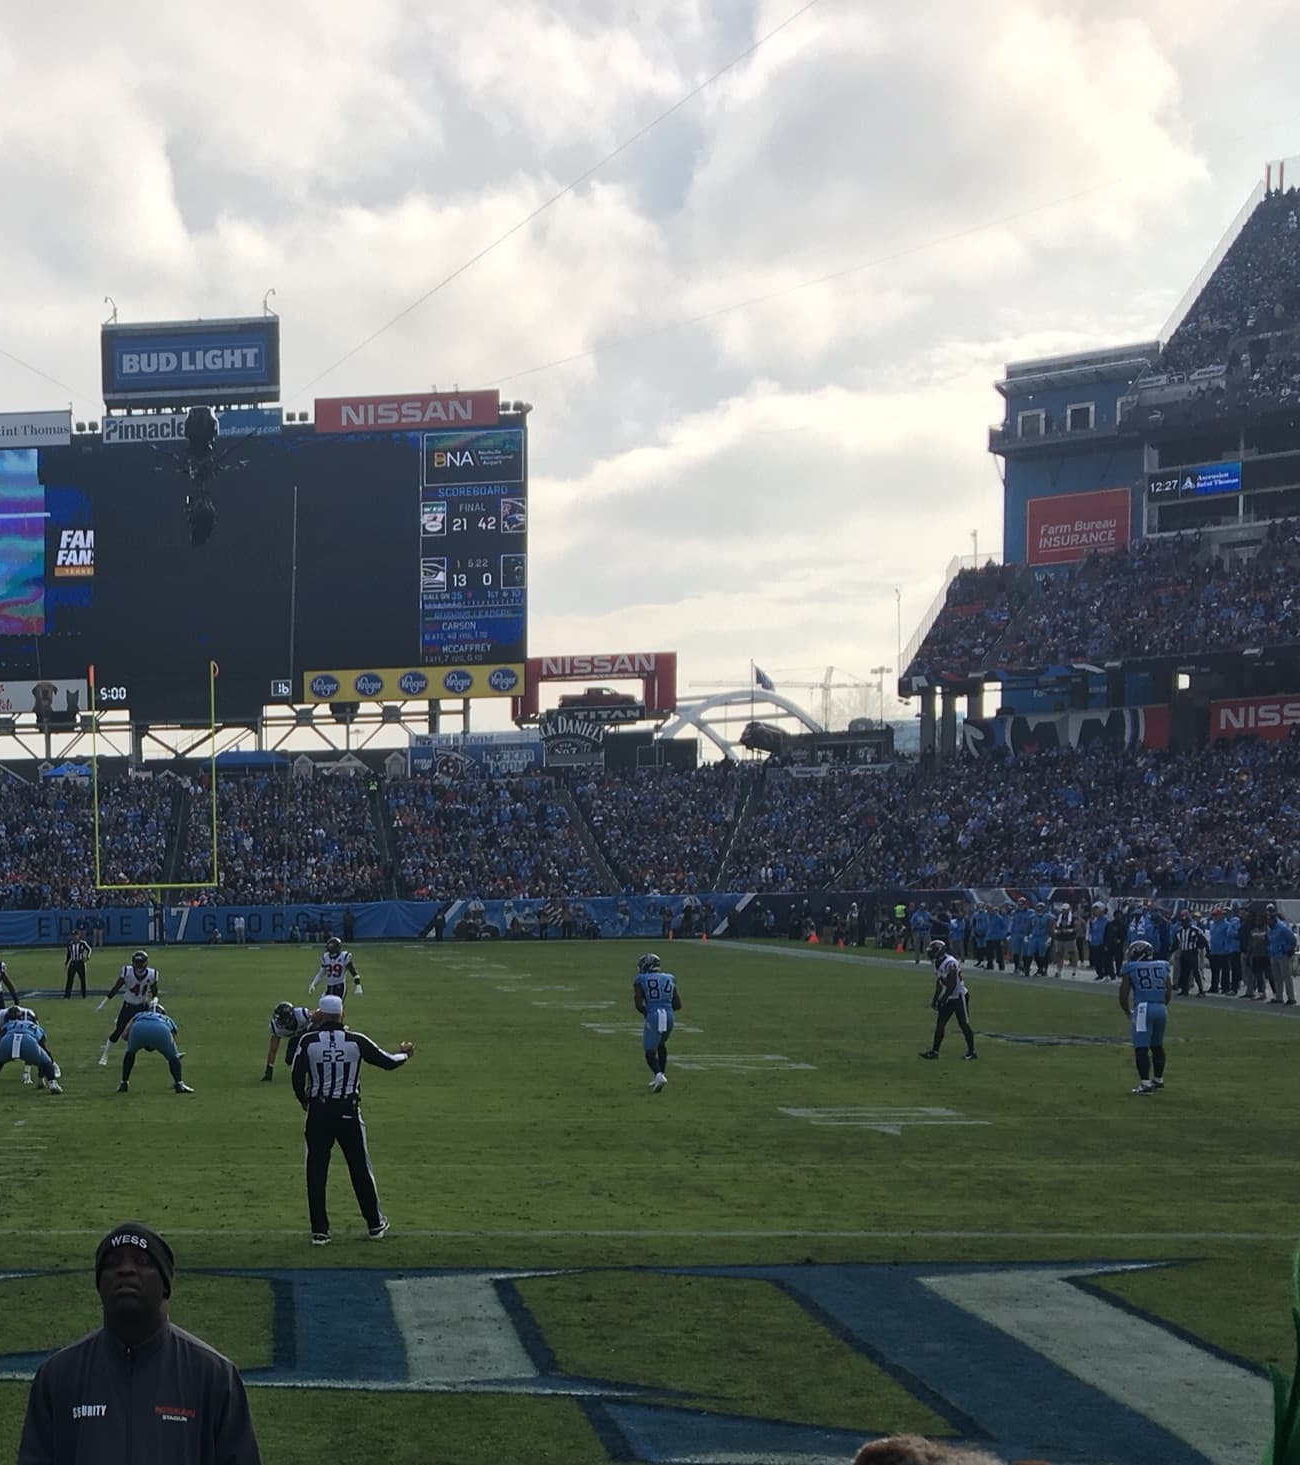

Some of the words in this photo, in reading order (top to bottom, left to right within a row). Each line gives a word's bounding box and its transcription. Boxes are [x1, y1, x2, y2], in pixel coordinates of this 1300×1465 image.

[122, 352, 178, 374] BUD
[181, 348, 260, 371] LIGHT
[341, 400, 472, 426] NISSAN
[20, 422, 70, 436] Thomas
[105, 417, 185, 441] Pinnacle
[438, 485, 508, 497] SCOREBOARD
[1150, 480, 1178, 493] 12:27
[460, 502, 486, 512] FINAL
[453, 518, 467, 531] 21
[478, 516, 496, 530] 42
[1040, 524, 1071, 536] Farm
[1075, 519, 1117, 531] Bureau
[1039, 530, 1117, 549] INSURANCE
[452, 574, 467, 587] 13
[483, 573, 492, 586] 0
[442, 621, 477, 631] CARSON
[442, 643, 492, 654] MCCAFFREY
[542, 653, 655, 675] NISSAN
[312, 678, 337, 696] Kroger
[357, 676, 382, 694] Kroger
[401, 675, 426, 693] Kroger
[446, 674, 471, 692] Kroger
[491, 671, 516, 690] Kroger
[100, 687, 127, 700] 5:00
[574, 710, 640, 719] TITAN
[1220, 703, 1300, 729] NISS
[1138, 967, 1165, 990] 85
[647, 979, 673, 999] 84
[329, 1042, 337, 1050] R
[322, 1050, 345, 1062] 52
[112, 1234, 148, 1249] WESS
